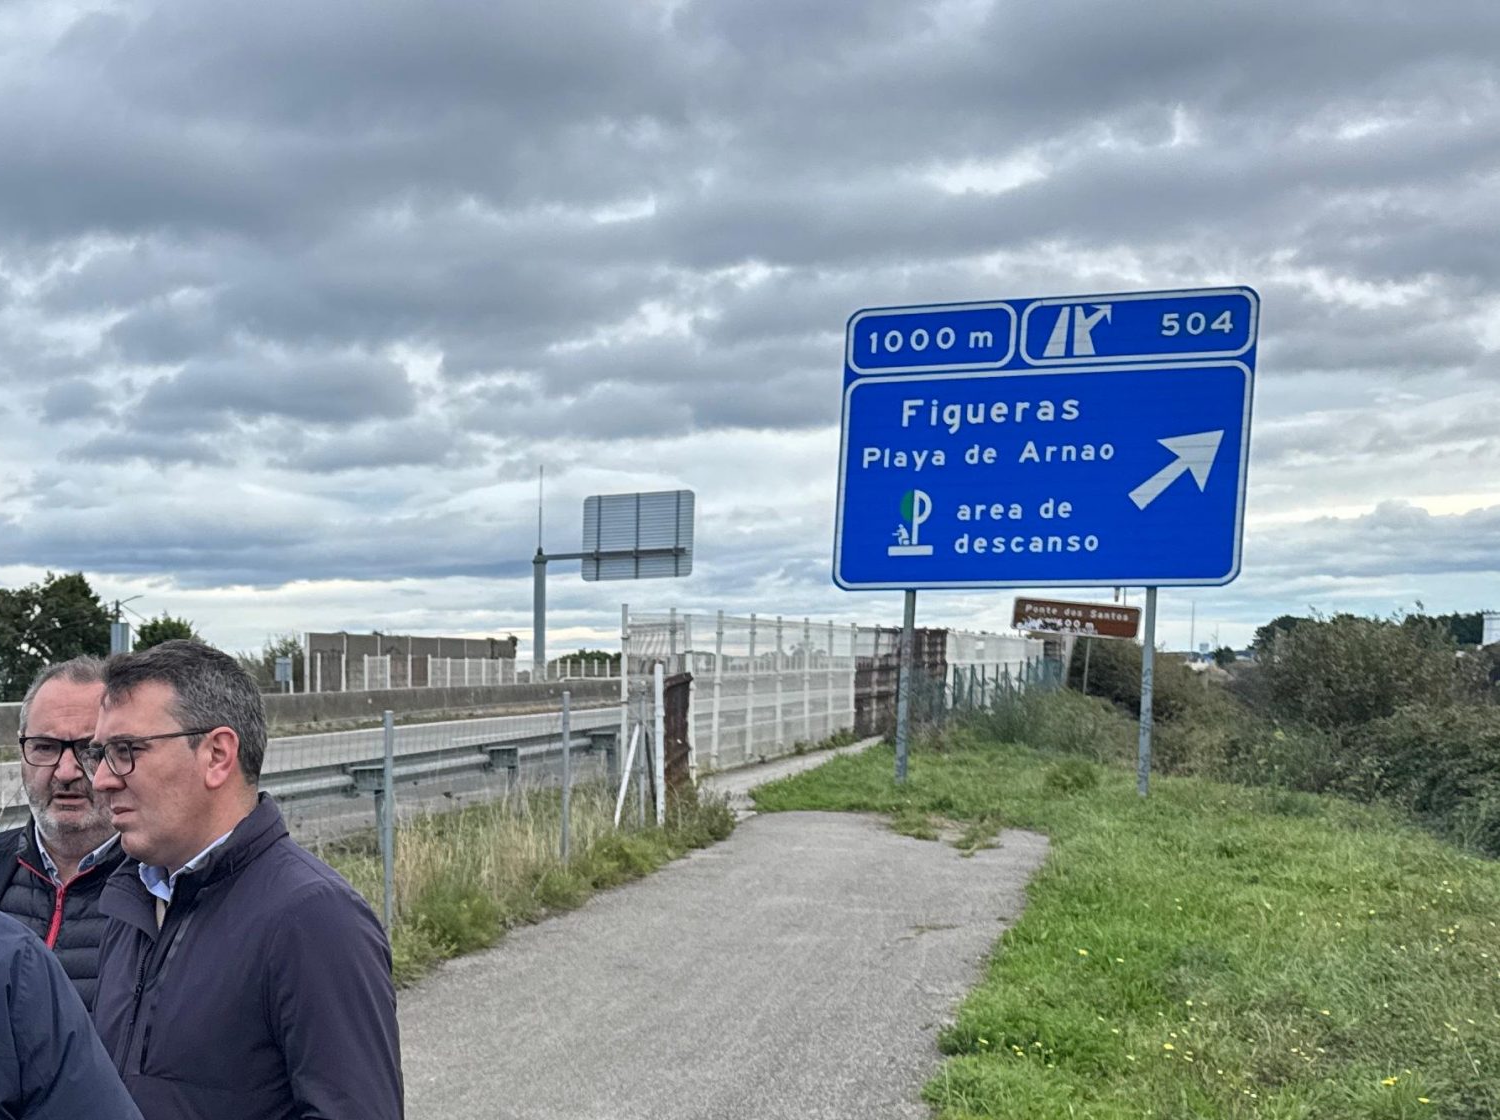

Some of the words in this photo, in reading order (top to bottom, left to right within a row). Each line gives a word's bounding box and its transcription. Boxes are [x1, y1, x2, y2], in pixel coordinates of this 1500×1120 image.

[1160, 310, 1234, 336] 504
[869, 327, 956, 354] 1000
[968, 330, 994, 348] m
[901, 398, 1081, 434] Figueras
[862, 447, 946, 472] Playa
[964, 444, 997, 465] de
[1019, 440, 1115, 463] Arnao
[956, 503, 1023, 521] area
[1039, 498, 1073, 519] de
[954, 531, 1100, 555] descanso
[1025, 603, 1058, 615] Ponte
[1064, 608, 1083, 617] dos
[1090, 609, 1129, 621] Santos
